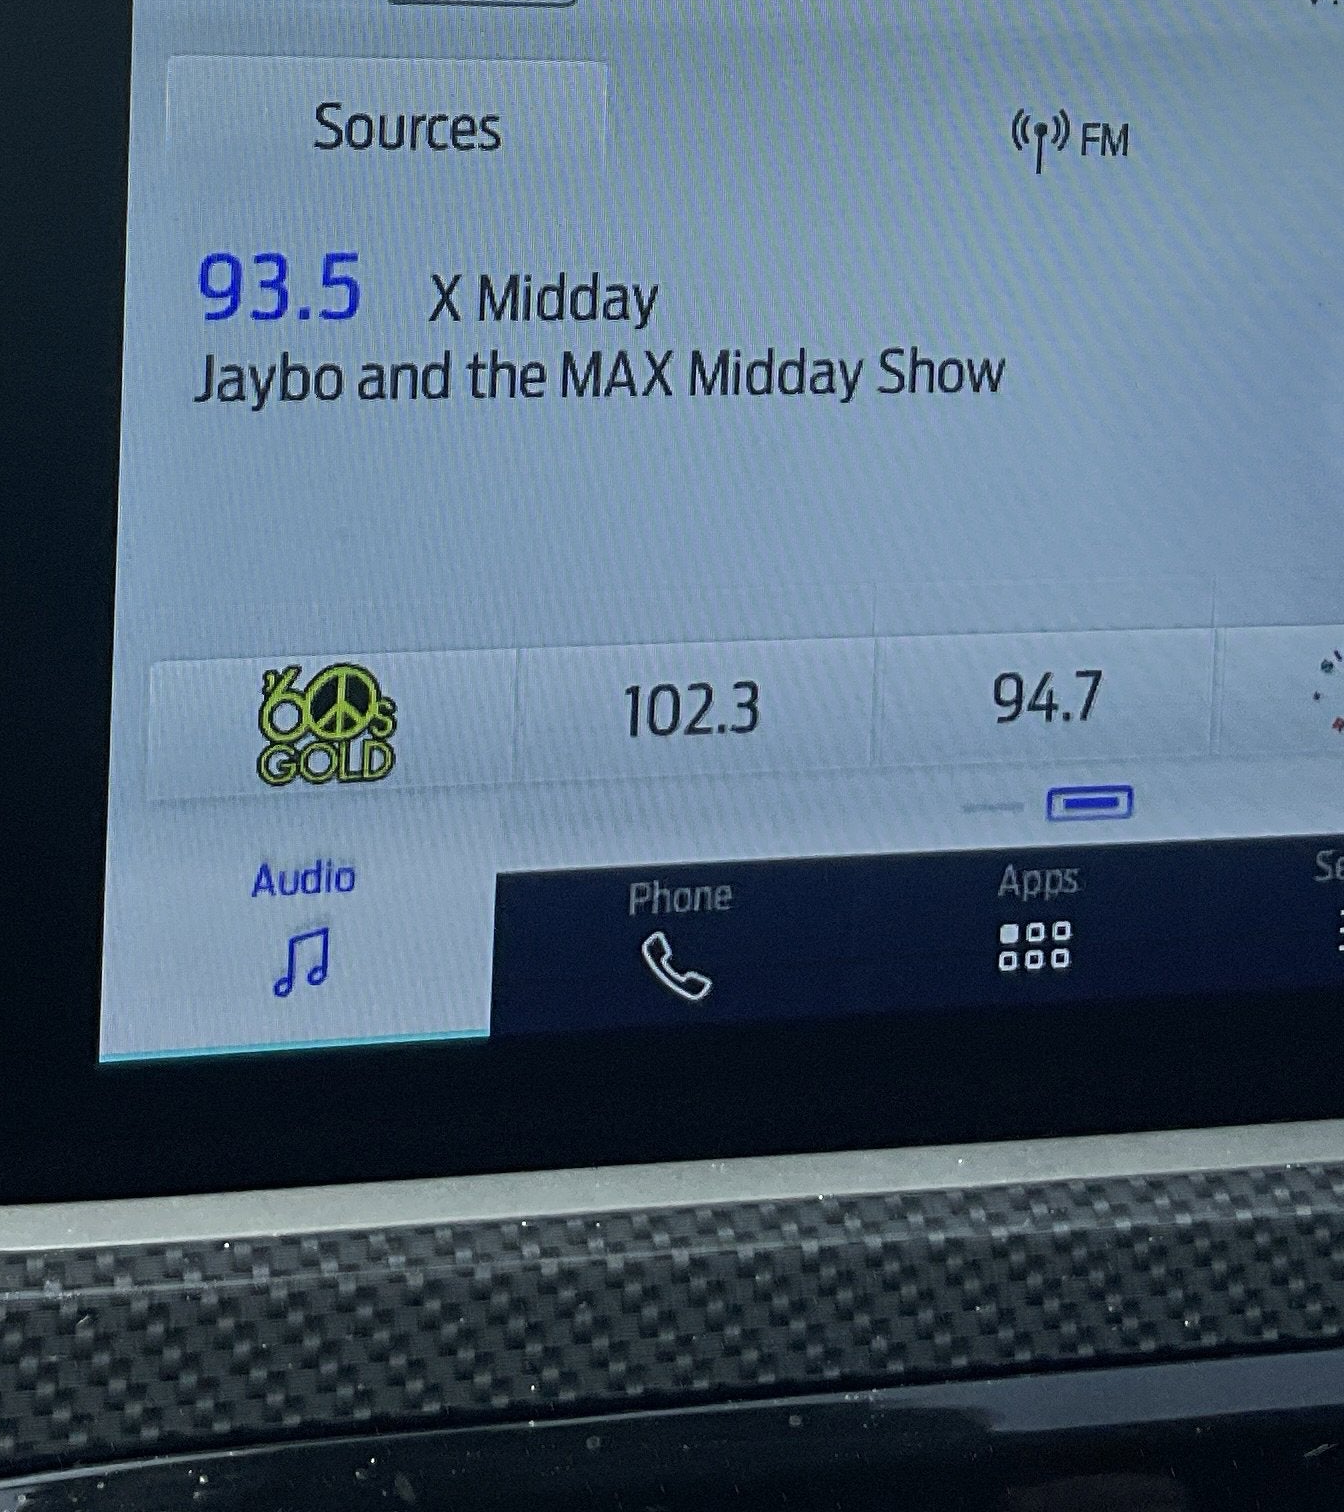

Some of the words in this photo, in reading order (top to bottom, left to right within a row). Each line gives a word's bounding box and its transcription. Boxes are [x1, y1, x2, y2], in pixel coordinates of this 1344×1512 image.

[313, 101, 503, 153] Sources
[1080, 122, 1130, 157] FM
[198, 251, 362, 322] 93.5
[428, 274, 463, 324] X
[478, 271, 659, 330] Midday
[193, 351, 344, 413] Jaybo
[357, 349, 452, 401] and
[465, 349, 549, 400] the
[561, 348, 674, 399] MAX
[689, 347, 865, 405] Midday
[876, 345, 1007, 395] Show
[625, 680, 761, 738] 102.3
[993, 669, 1103, 725] 94.7
[257, 738, 396, 786] GOLD
[251, 857, 357, 899] Audio
[628, 878, 735, 917] Phone
[998, 862, 1081, 903] Apps
